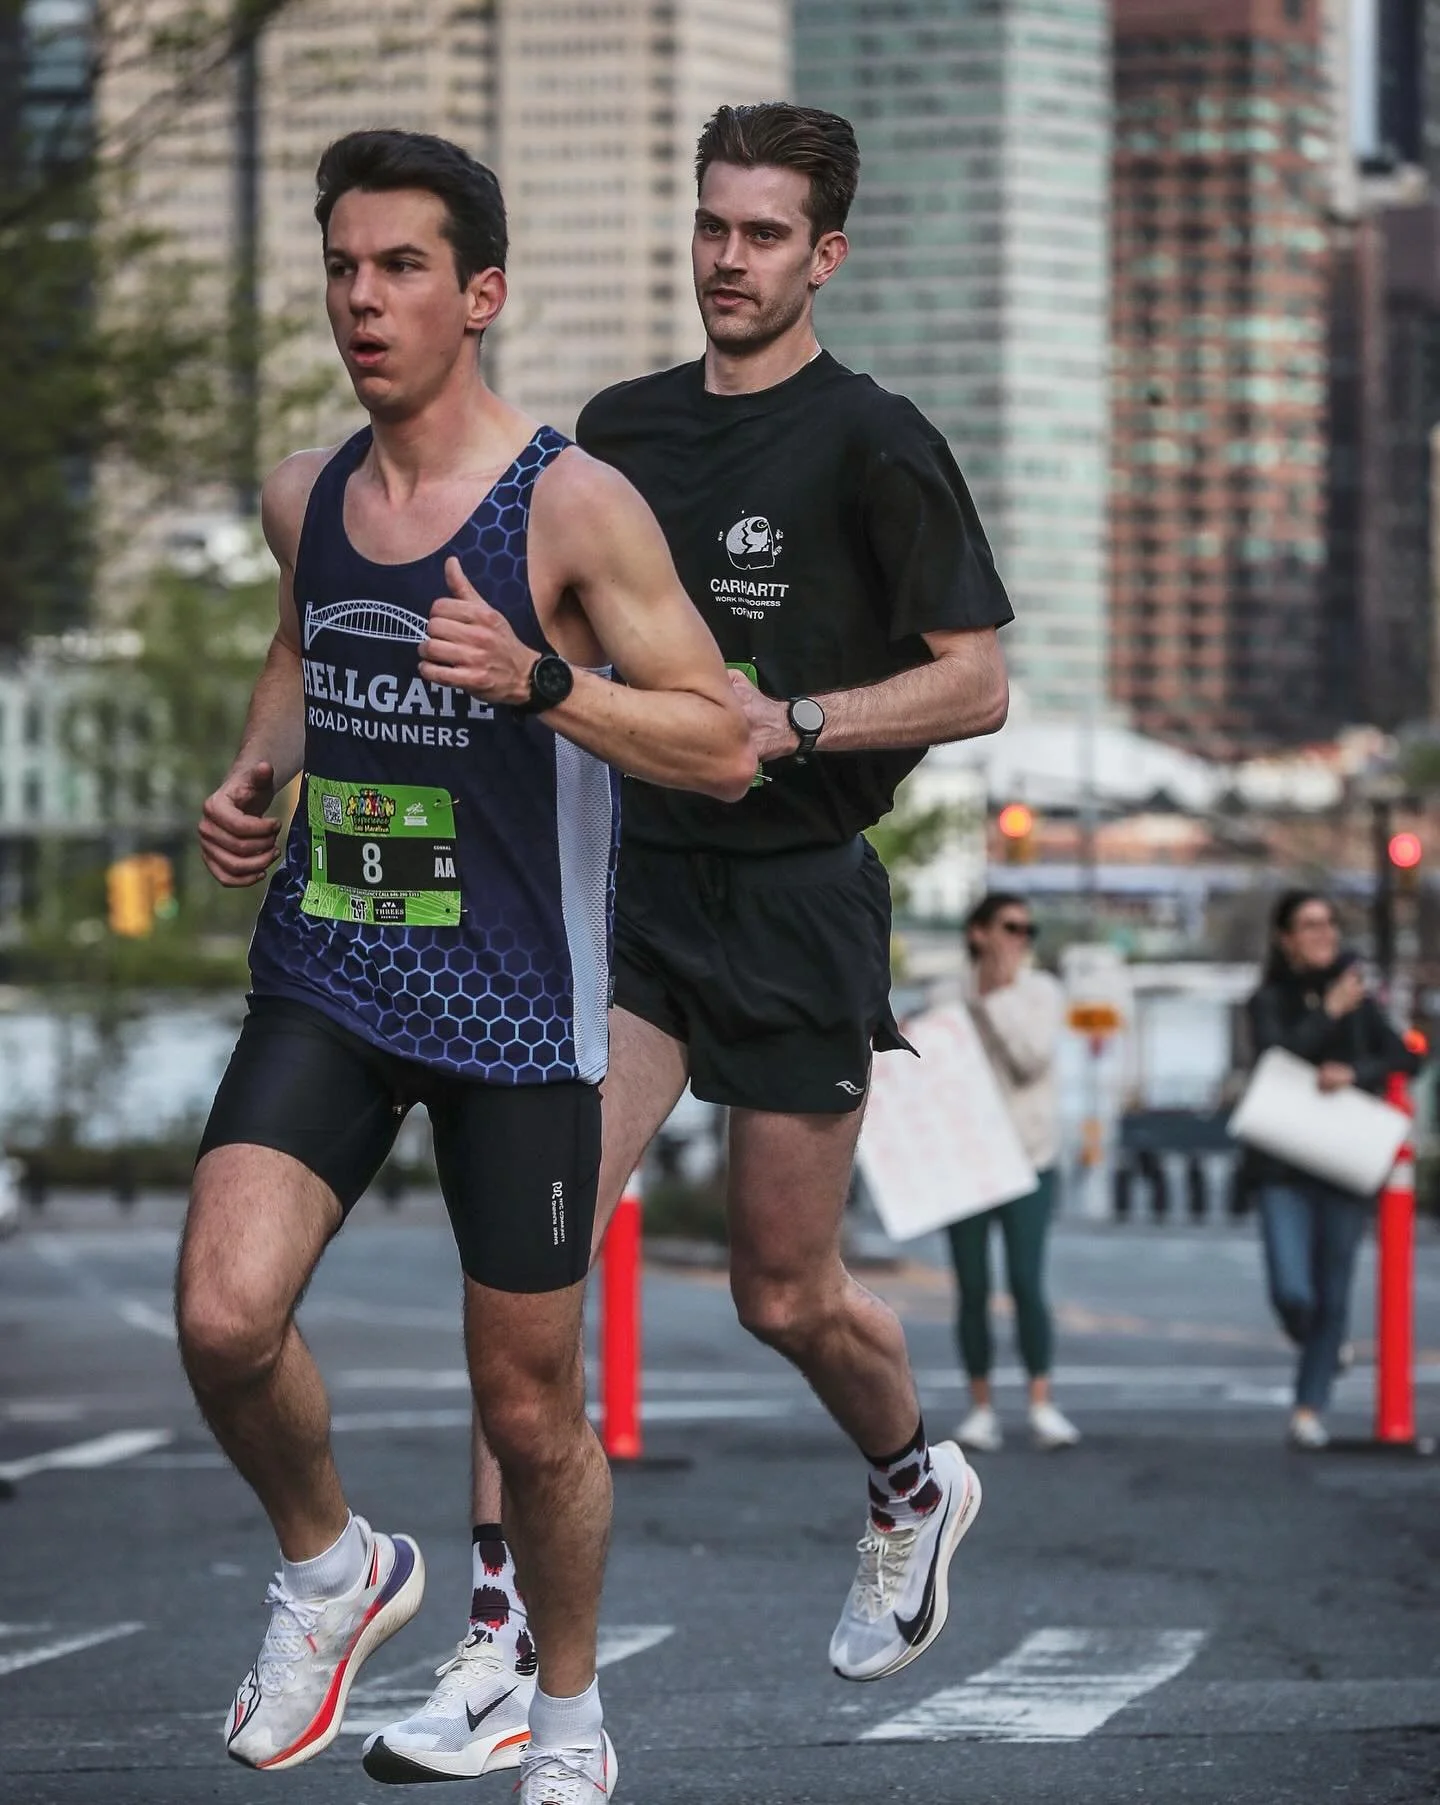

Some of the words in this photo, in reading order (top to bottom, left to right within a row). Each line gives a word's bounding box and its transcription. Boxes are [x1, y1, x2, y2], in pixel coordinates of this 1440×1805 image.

[710, 578, 789, 598] CARHARTT
[730, 607, 764, 619] TORNTO
[308, 706, 348, 732] ROAD
[351, 719, 470, 747] RUNNERS
[314, 845, 323, 870] 1
[362, 842, 383, 884] 8
[434, 857, 456, 878] AA
